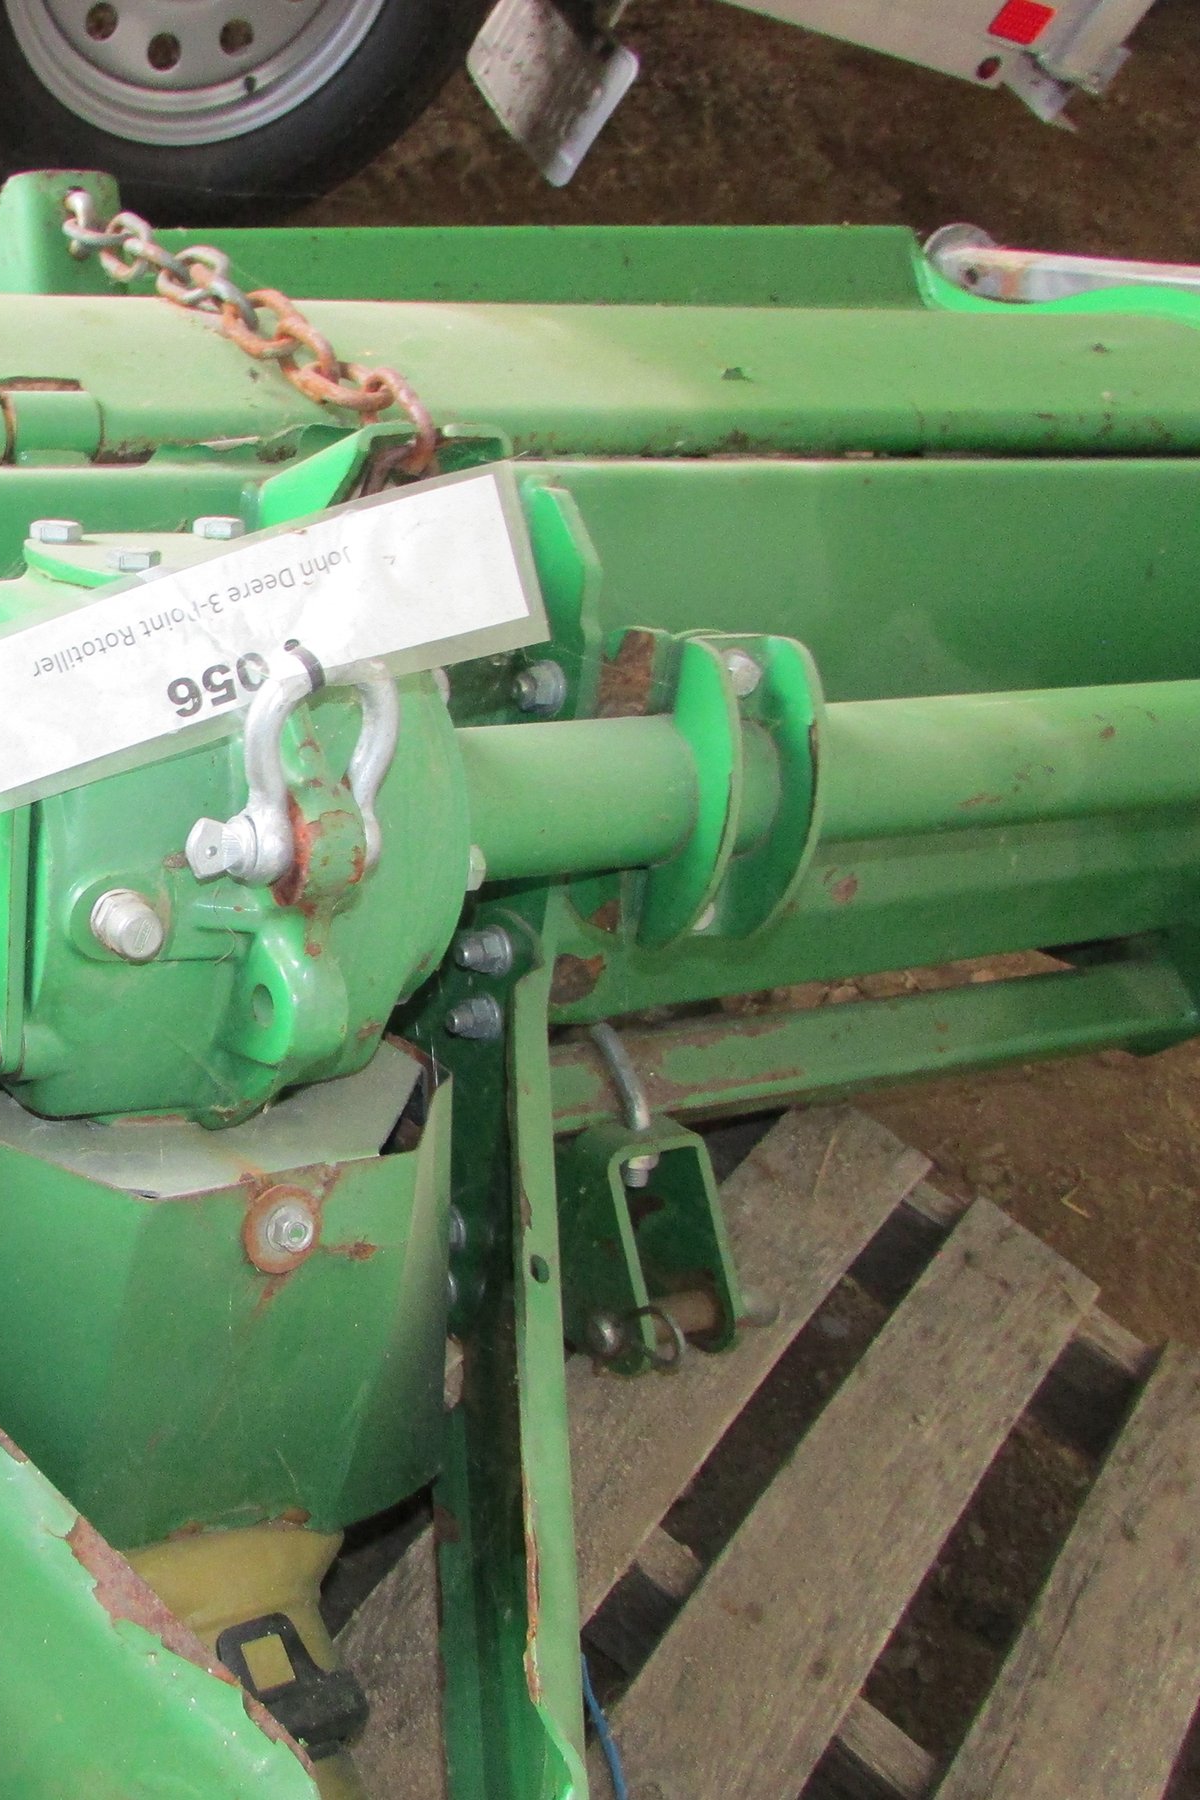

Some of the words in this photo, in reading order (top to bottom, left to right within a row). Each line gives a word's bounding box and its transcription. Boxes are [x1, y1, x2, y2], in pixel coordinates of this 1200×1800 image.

[300, 546, 351, 577] John
[227, 568, 296, 602] Deere
[33, 625, 136, 677] Rototiller
[167, 652, 270, 718] 056
